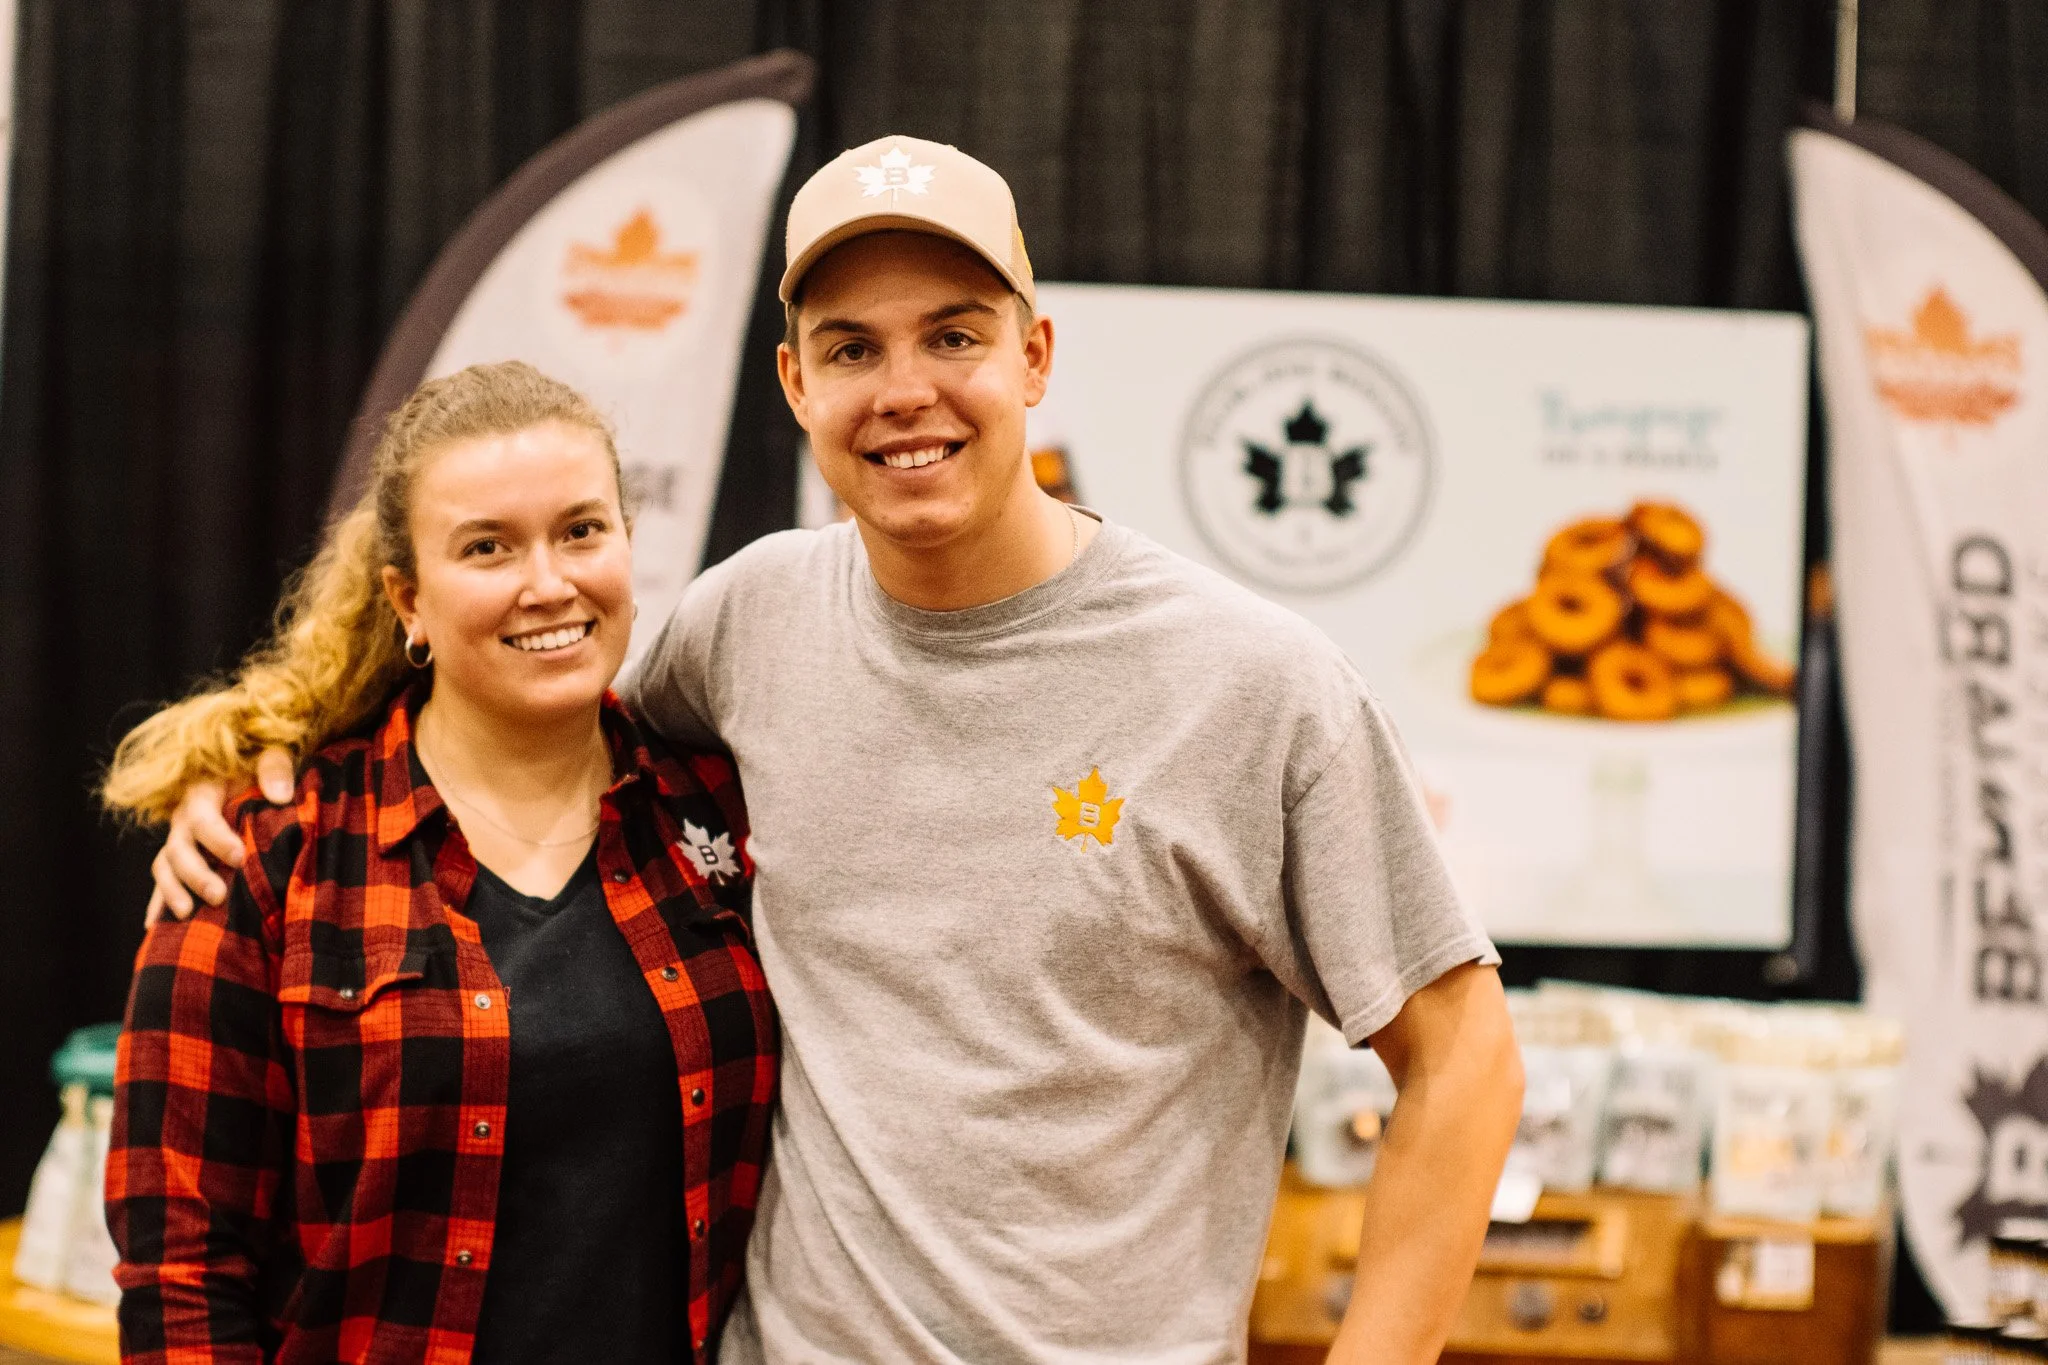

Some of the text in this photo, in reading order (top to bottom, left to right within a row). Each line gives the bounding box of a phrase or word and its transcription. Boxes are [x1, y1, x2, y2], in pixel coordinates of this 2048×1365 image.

[884, 166, 910, 186] B
[1079, 801, 1101, 829] B
[697, 844, 720, 866] B
